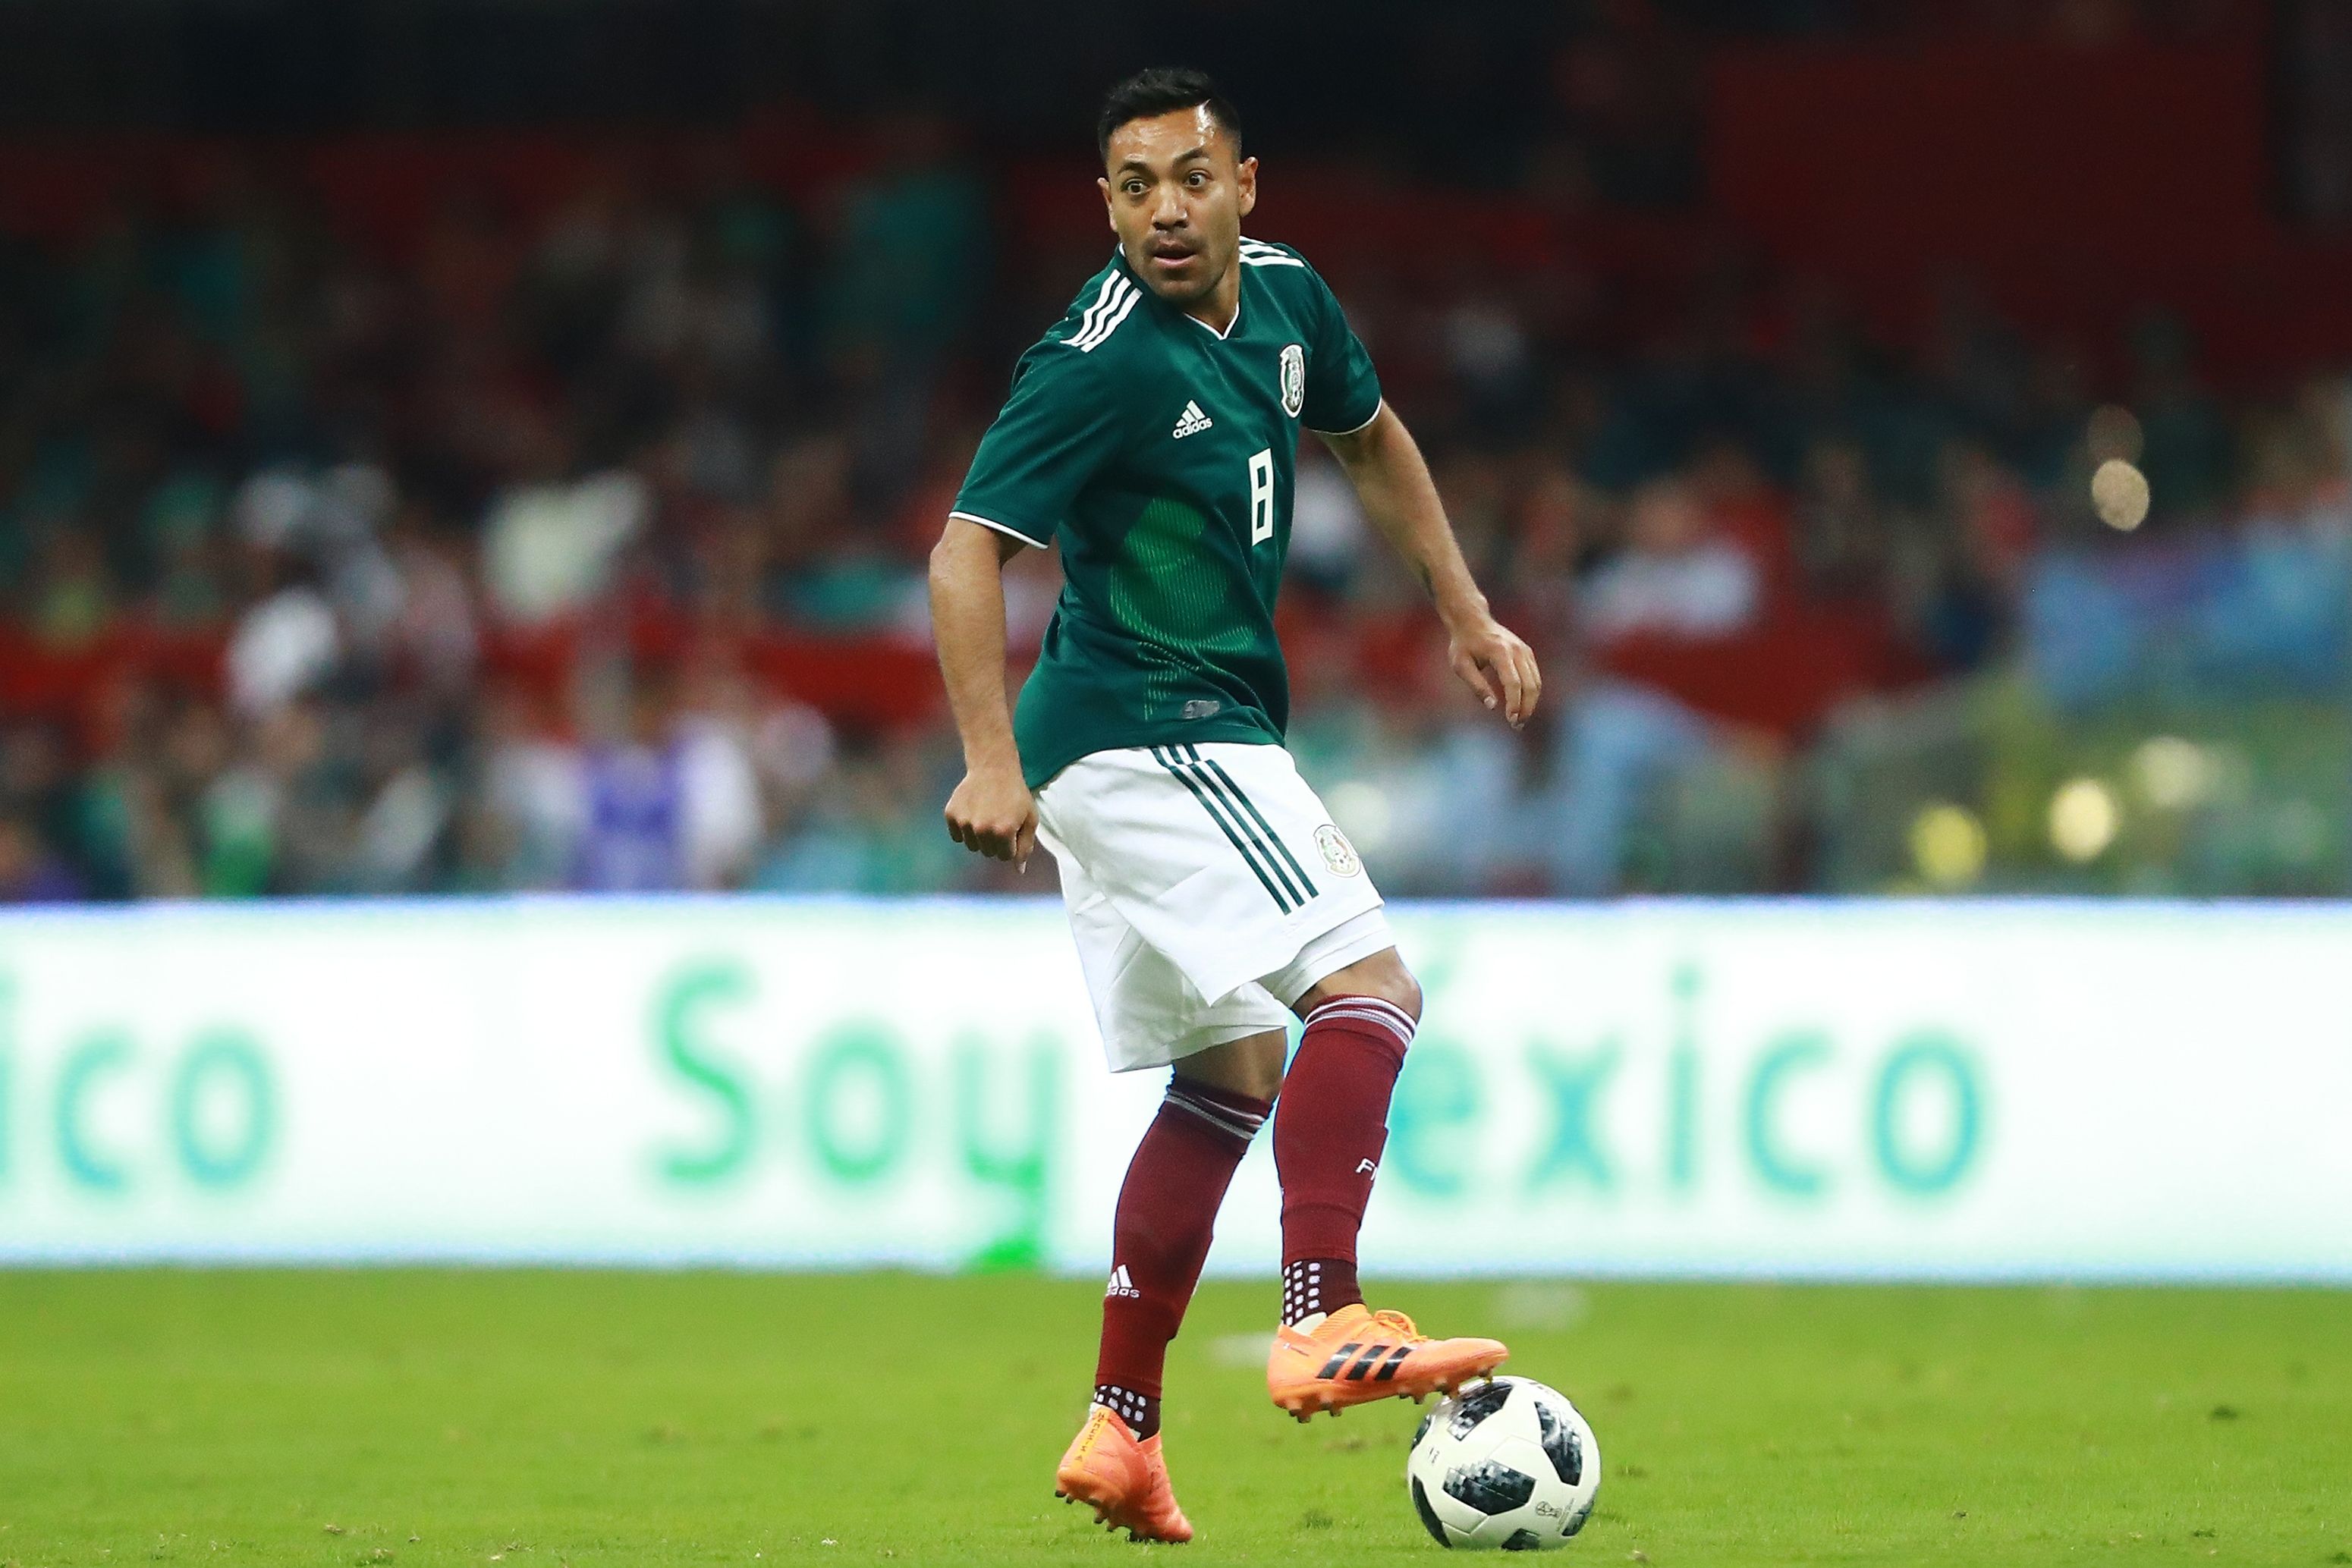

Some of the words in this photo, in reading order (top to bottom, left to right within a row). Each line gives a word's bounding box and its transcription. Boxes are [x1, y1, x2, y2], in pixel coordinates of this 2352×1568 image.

[1172, 417, 1213, 439] adidas
[1248, 448, 1274, 546] 8
[651, 963, 1068, 1271] Soy
[1390, 962, 1989, 1205] éxico
